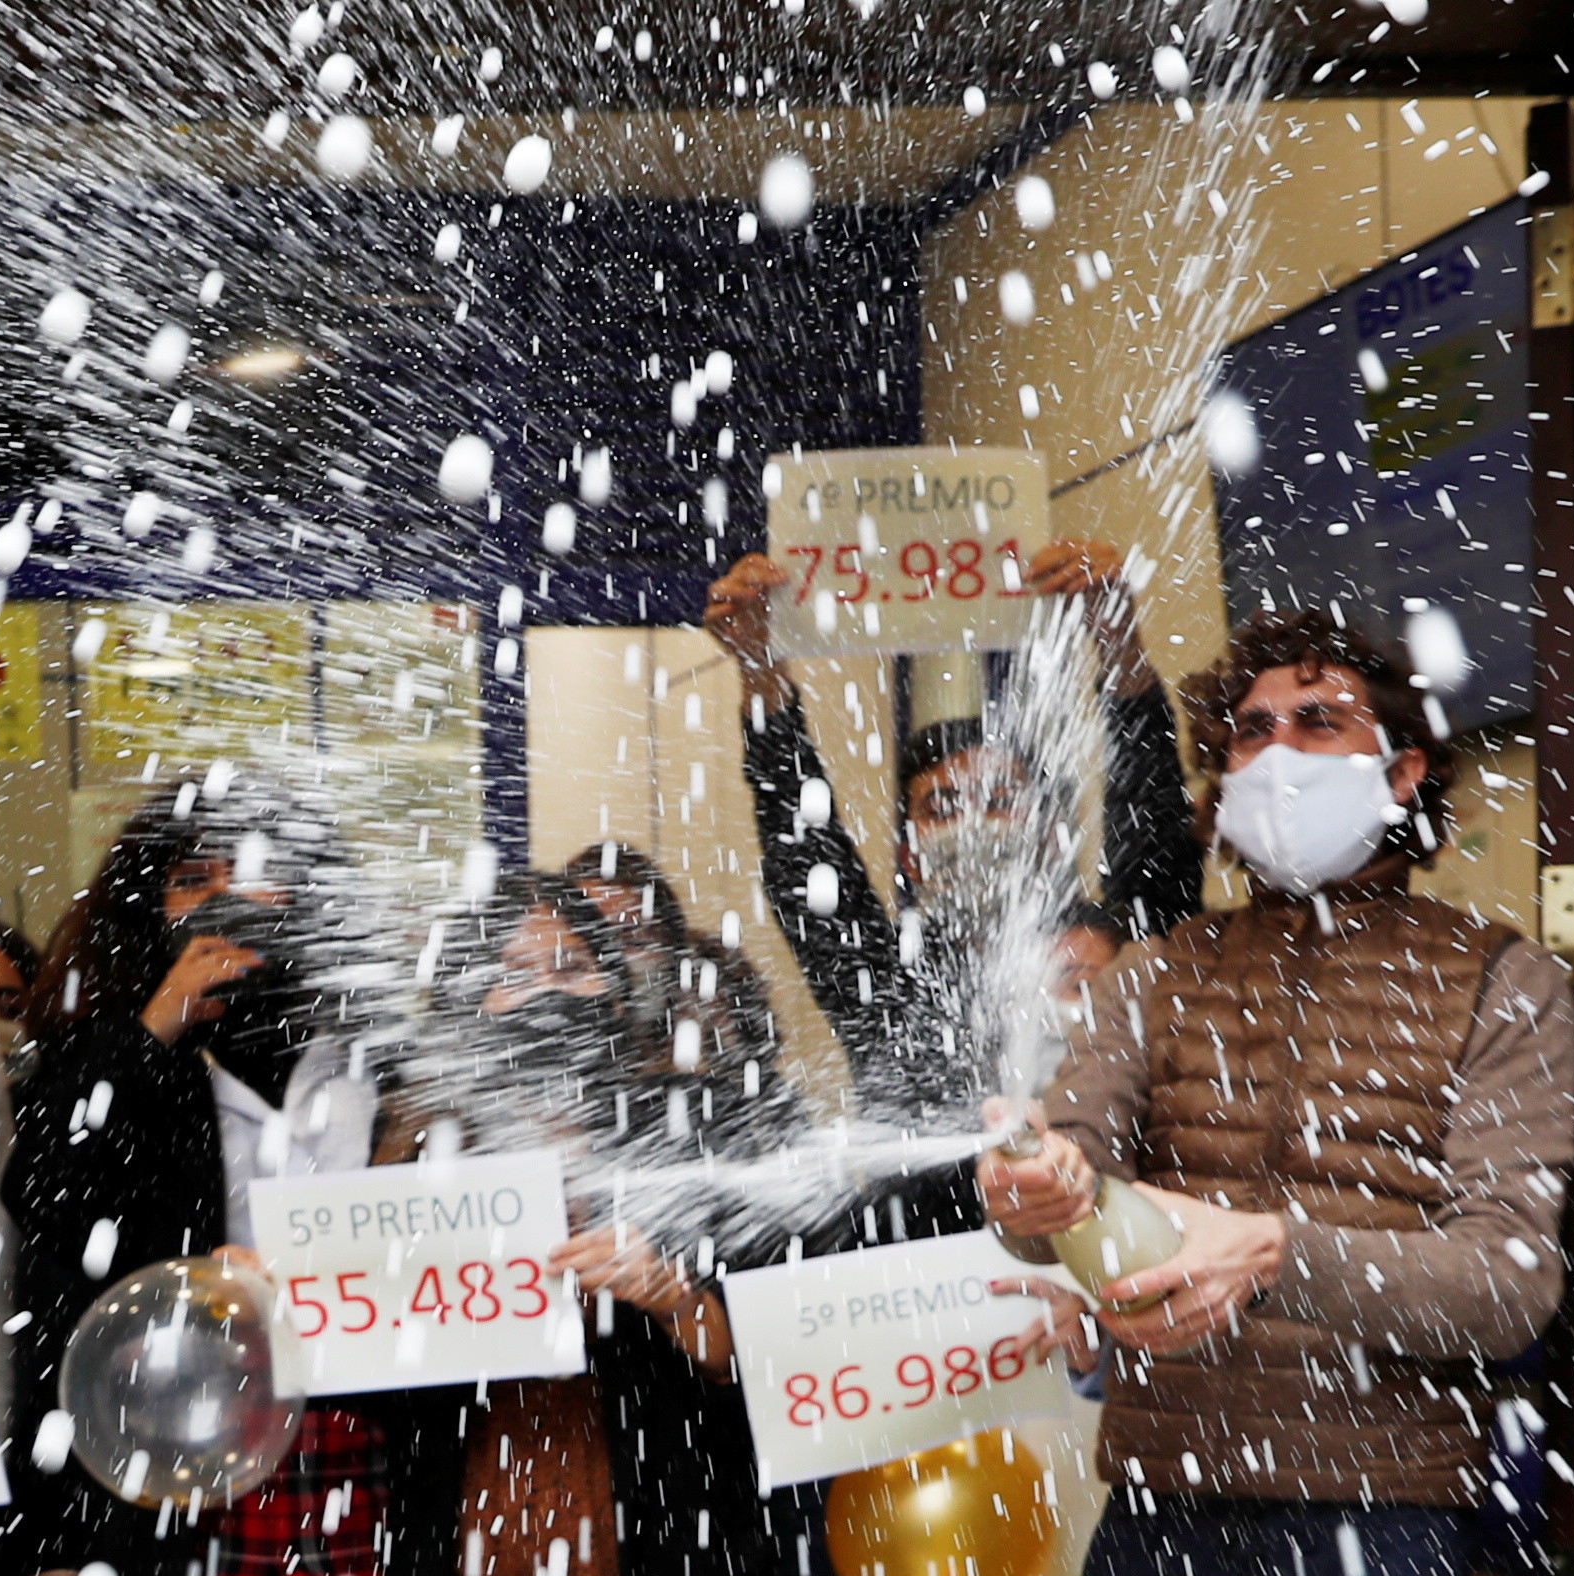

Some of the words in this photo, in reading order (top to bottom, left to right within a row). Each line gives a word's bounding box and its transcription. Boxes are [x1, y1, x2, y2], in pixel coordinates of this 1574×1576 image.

[854, 474, 1016, 513] PREMIO
[786, 537, 1033, 606] 75.981
[288, 1206, 333, 1248] 5º
[349, 1187, 524, 1241] PREMIO
[288, 1257, 551, 1338] 55.483
[797, 1301, 836, 1339] 5º
[849, 1275, 985, 1327] PREMIO
[783, 1335, 1025, 1428] 86.986
